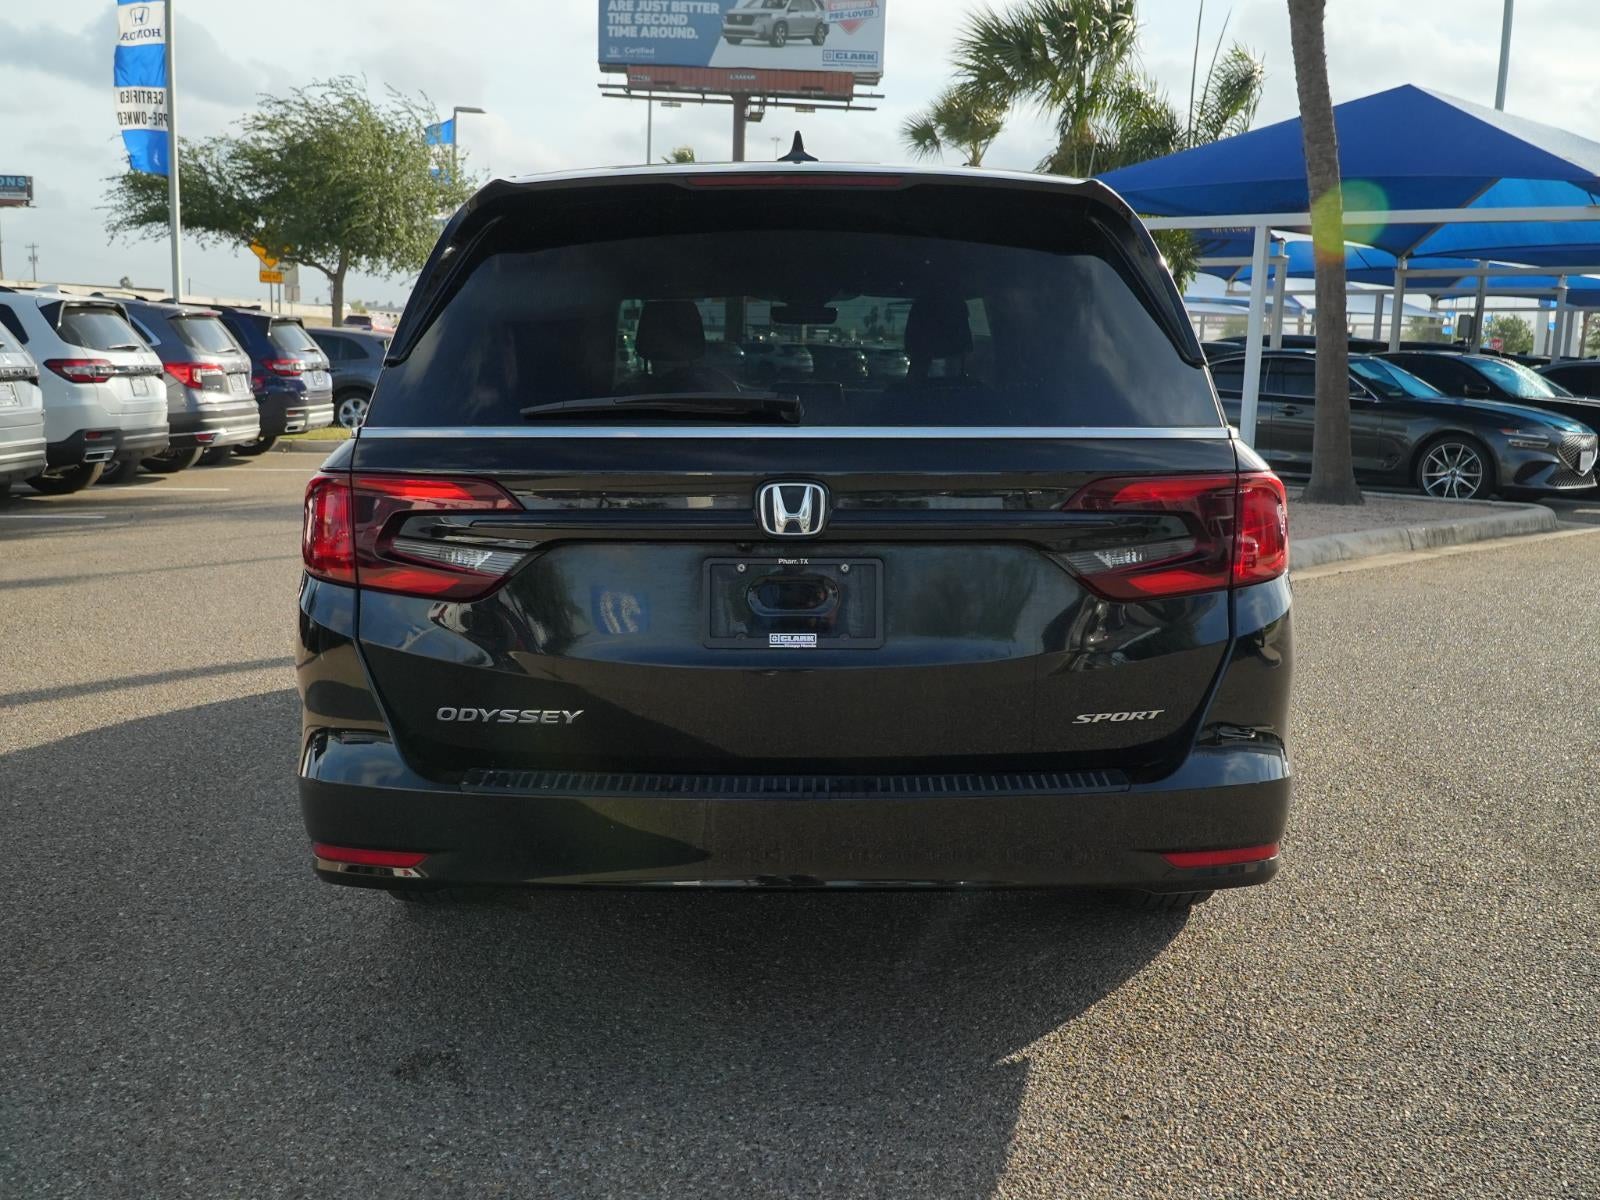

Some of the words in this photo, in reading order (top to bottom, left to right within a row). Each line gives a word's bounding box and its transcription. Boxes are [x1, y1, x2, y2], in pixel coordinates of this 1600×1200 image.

[607, 0, 634, 11] ARE
[637, 0, 669, 12] JUST
[671, 1, 720, 14] BETTER
[607, 12, 633, 25] THE
[634, 13, 689, 26] SECOND
[828, 9, 874, 20] PRE-LOVED
[607, 25, 638, 38] TIME
[640, 26, 699, 40] AROUND.
[624, 46, 655, 55] Certified
[835, 52, 875, 61] CLARK
[436, 707, 585, 724] ODYSSEY
[1071, 709, 1165, 724] SPORT
